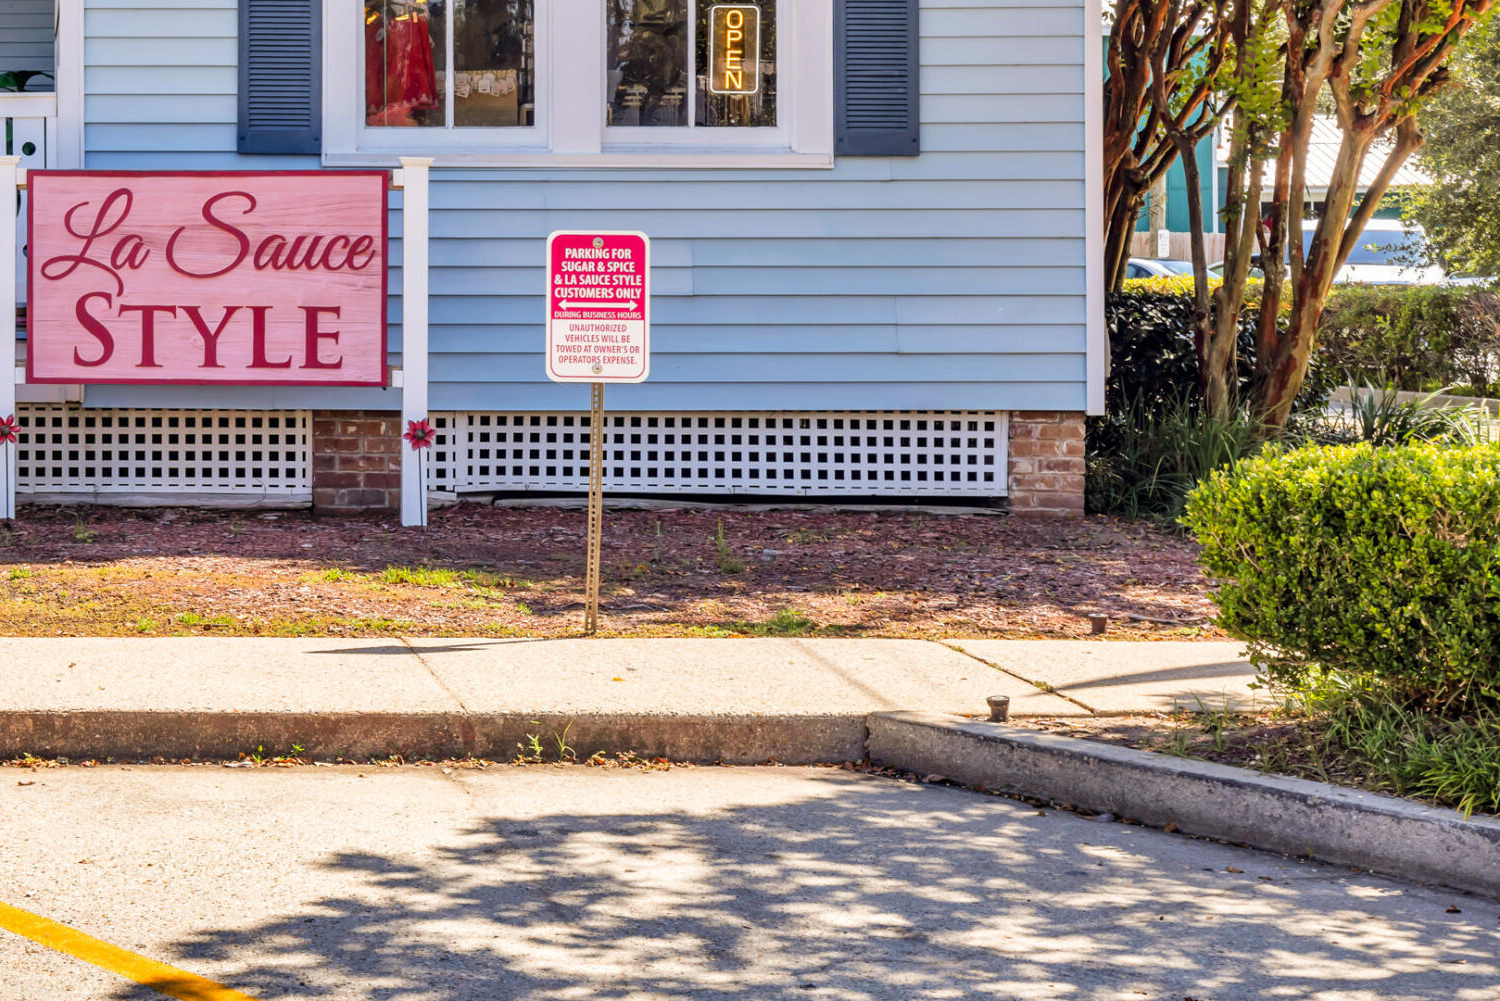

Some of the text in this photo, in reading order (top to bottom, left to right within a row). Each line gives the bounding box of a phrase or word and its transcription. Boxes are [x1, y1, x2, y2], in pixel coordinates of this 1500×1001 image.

[725, 9, 744, 90] OPEN
[41, 187, 376, 297] La Sauce
[565, 248, 632, 259] PARKING FOR
[561, 261, 635, 272] SUGAR & SPICE
[554, 274, 642, 286] & LA SAUCE STYLE
[554, 287, 642, 299] CUSTOMERS ONLY
[73, 291, 344, 370] STYLE
[569, 324, 627, 332] UNAUTHORIZED
[565, 335, 630, 343] VEHICLES WILL BE
[556, 345, 582, 353] TOWED
[584, 345, 592, 353] AT
[594, 345, 627, 353] OWNER'S
[558, 355, 601, 364] OPERATORS
